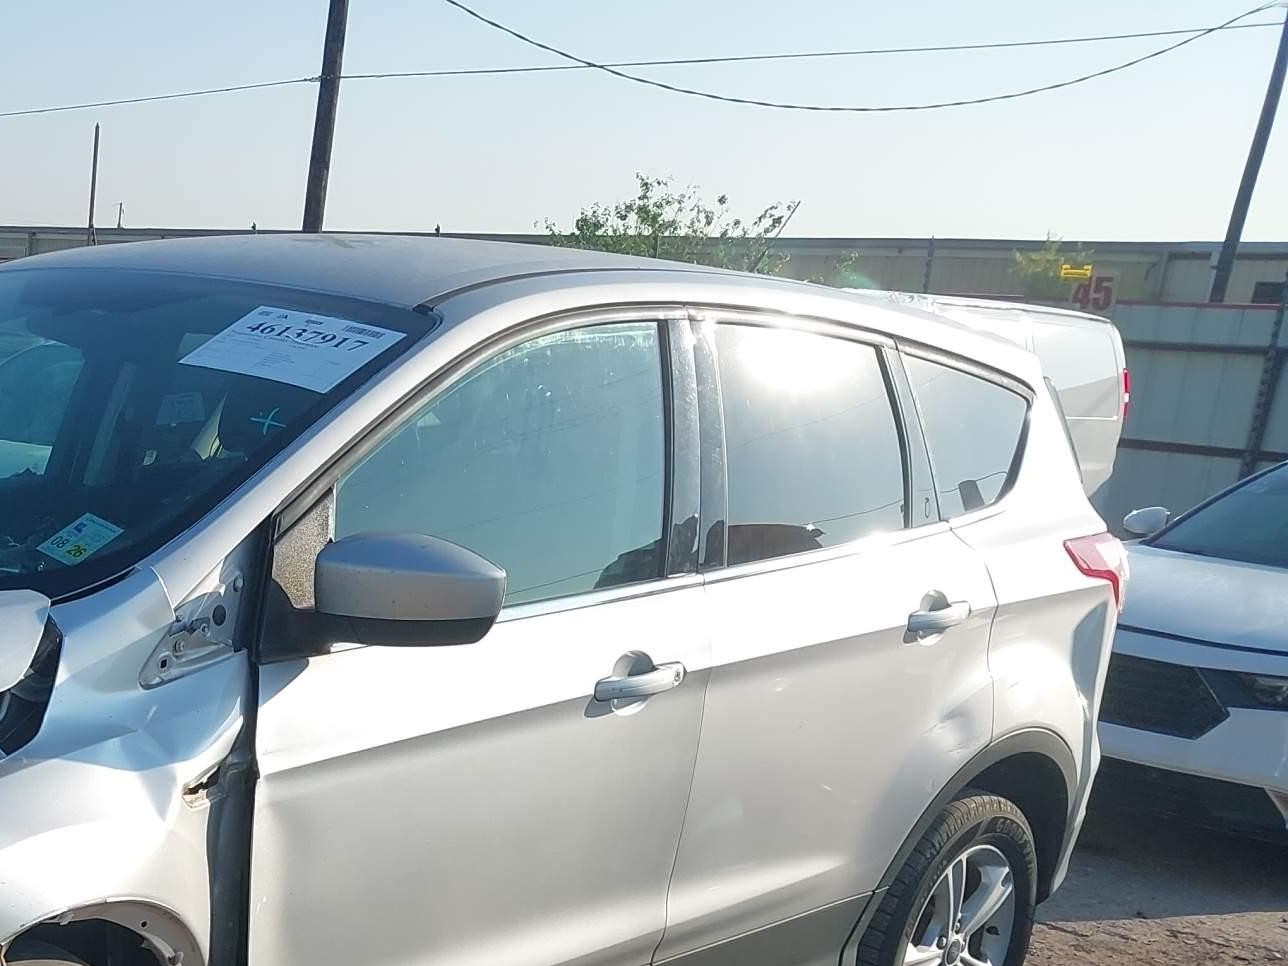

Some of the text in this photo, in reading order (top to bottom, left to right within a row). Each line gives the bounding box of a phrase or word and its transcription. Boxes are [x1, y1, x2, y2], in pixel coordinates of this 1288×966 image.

[1071, 276, 1114, 311] 45
[246, 321, 370, 352] 46137917
[50, 535, 88, 558] 08 26
